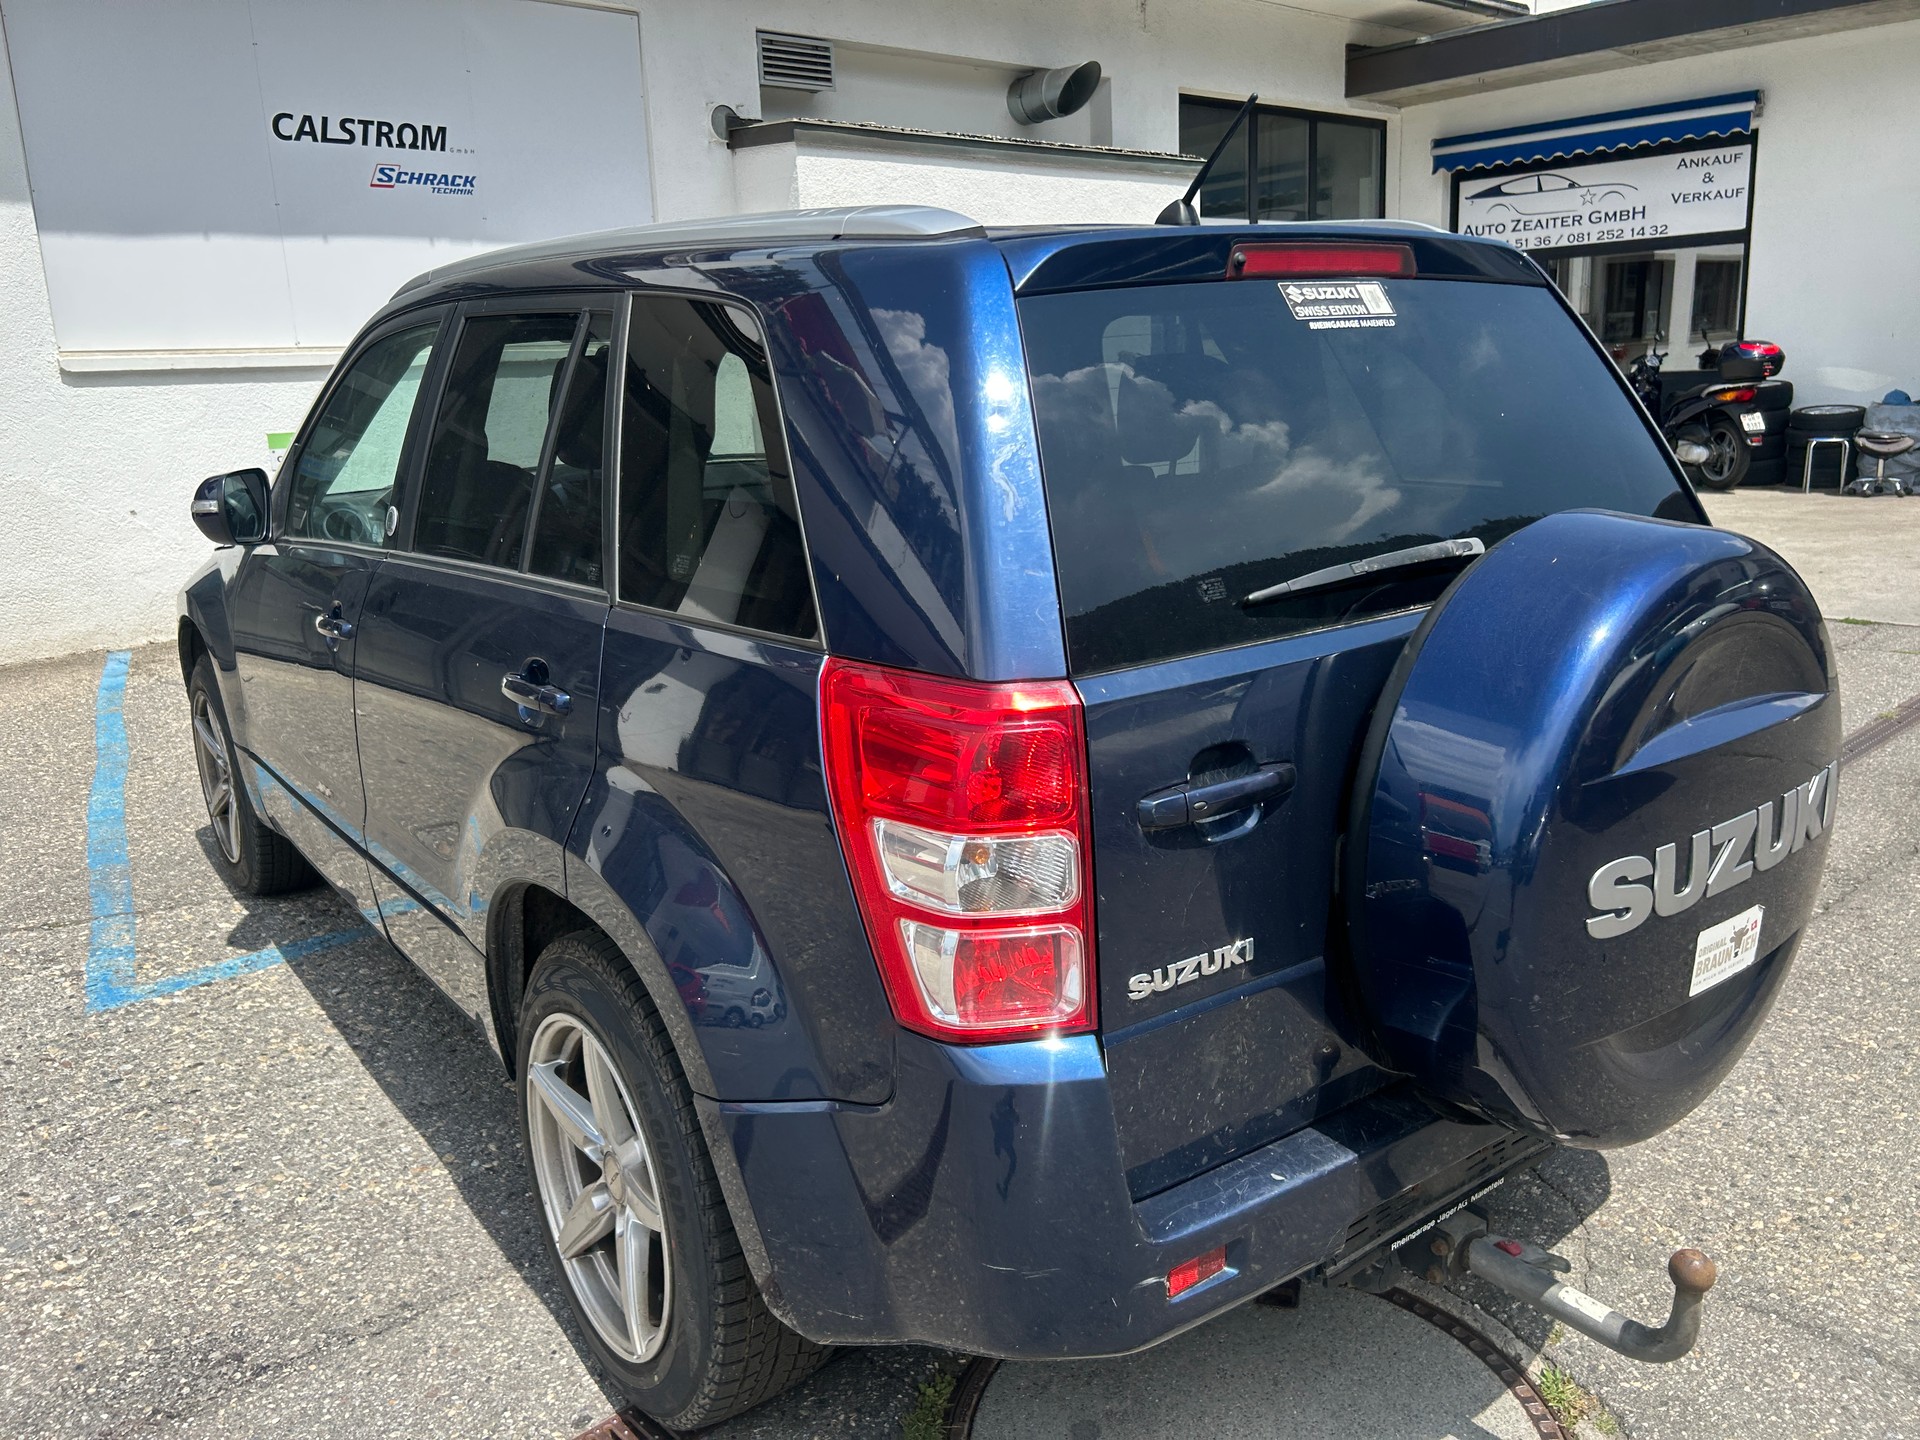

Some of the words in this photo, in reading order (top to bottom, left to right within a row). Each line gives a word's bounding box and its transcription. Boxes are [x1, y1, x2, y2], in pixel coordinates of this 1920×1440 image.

[1677, 152, 1743, 170] ANKAUF
[376, 167, 476, 188] SCHRACK
[1702, 172, 1714, 184] &
[431, 187, 474, 196] TECHNIK
[1671, 187, 1745, 204] VERKAUF
[1463, 223, 1506, 237] AUTO
[1511, 215, 1583, 233] ZEAITER
[1515, 239, 1529, 249] 51
[1534, 236, 1551, 247] 36
[1567, 232, 1591, 244] 081
[1597, 229, 1624, 241] 252
[1631, 227, 1646, 238] 14
[1649, 224, 1669, 236] 32
[1302, 287, 1360, 300] SUZUKI
[1296, 305, 1329, 316] SWISS
[1329, 305, 1368, 315] EDITION
[1309, 320, 1360, 330] RHEINGARAGE
[1585, 760, 1838, 939] SUZUKI
[1695, 931, 1758, 978] BRAUNIEH
[1698, 937, 1727, 958] ORIGINAL
[1127, 937, 1254, 1001] SUZUKI
[1391, 1219, 1436, 1251] Rheingarage
[1457, 1199, 1468, 1212] AG
